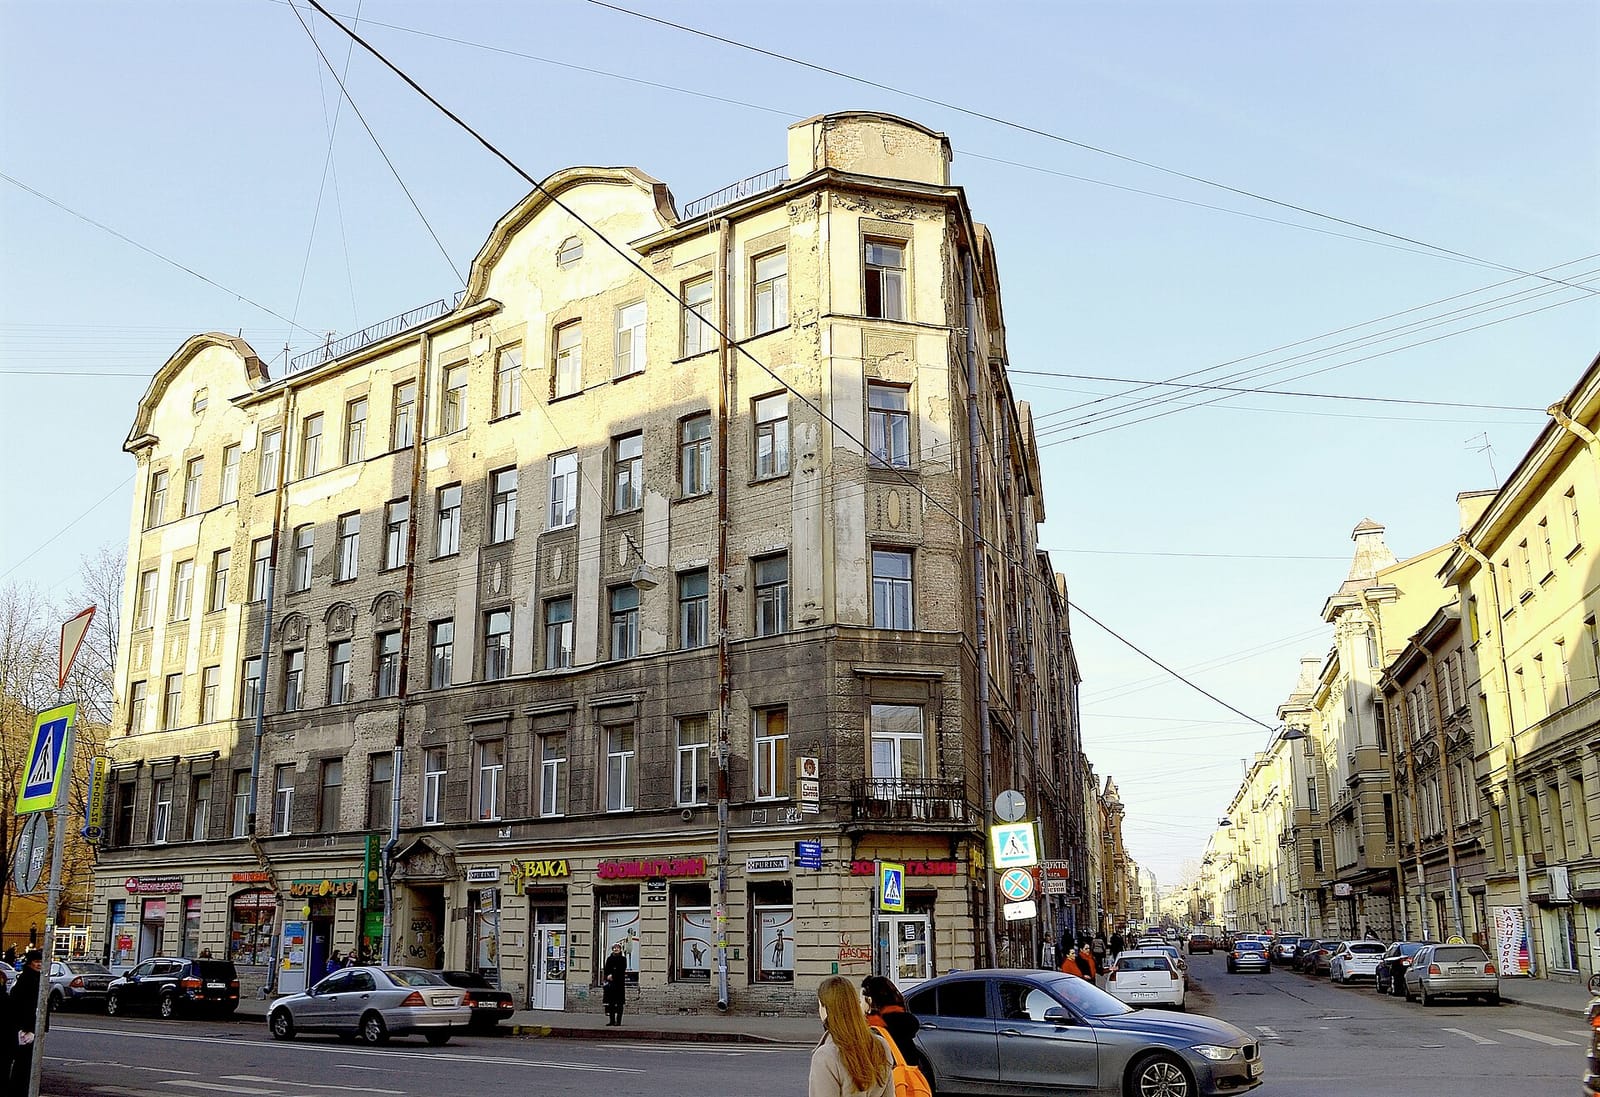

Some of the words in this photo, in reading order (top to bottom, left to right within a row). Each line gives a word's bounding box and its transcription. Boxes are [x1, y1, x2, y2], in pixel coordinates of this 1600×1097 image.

[598, 857, 705, 879] ЗООМАГАЗИН
[755, 861, 783, 869] PURINA
[851, 861, 956, 875] ЗОГАЗИН
[290, 883, 319, 896] МОРЕ
[328, 881, 353, 895] МАЯ
